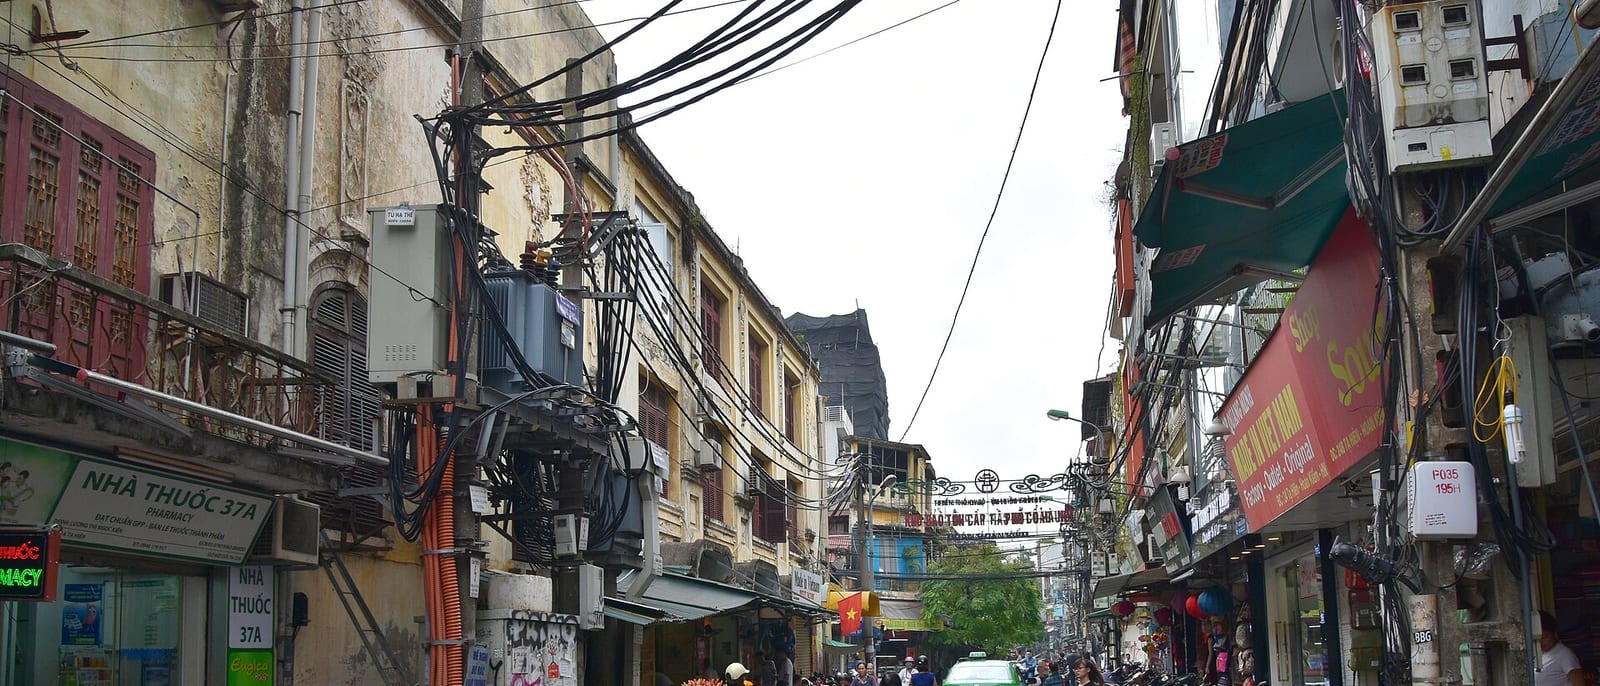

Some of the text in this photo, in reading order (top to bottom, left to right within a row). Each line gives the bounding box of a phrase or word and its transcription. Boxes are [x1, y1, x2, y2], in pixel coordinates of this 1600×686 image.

[1289, 308, 1320, 353] Shop
[1272, 383, 1303, 444] NAM
[1243, 481, 1265, 508] Factory
[1263, 461, 1285, 491] Outlet
[1284, 434, 1315, 474] Original
[82, 470, 258, 520] NHÀ THUỐC 37A
[145, 507, 195, 523] PHARMACY
[239, 566, 264, 586] NHÀ
[231, 592, 271, 614] THUỐC
[240, 626, 262, 643] 37A
